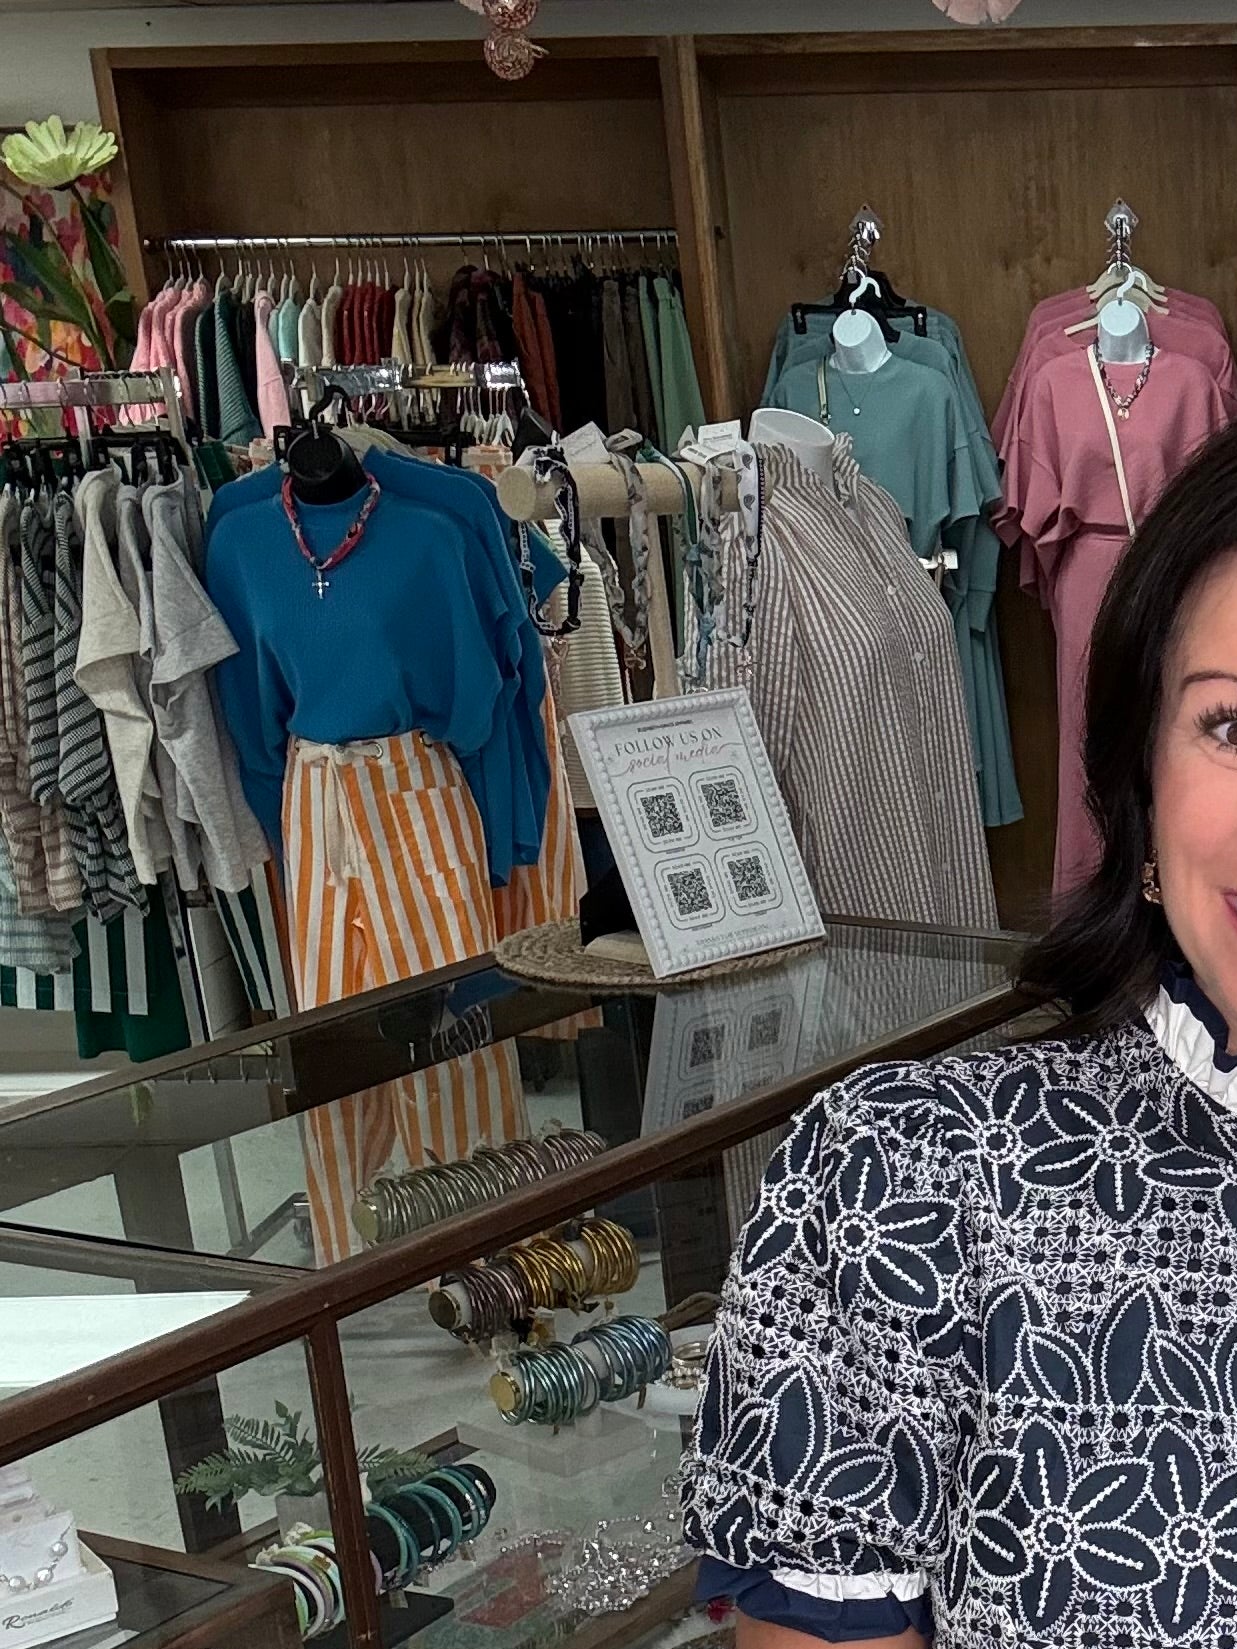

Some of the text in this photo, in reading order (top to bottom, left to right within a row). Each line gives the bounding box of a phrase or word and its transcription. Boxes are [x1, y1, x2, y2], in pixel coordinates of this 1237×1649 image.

[614, 735, 675, 757] FOLLOW
[679, 731, 698, 746] US
[701, 726, 723, 741] ON
